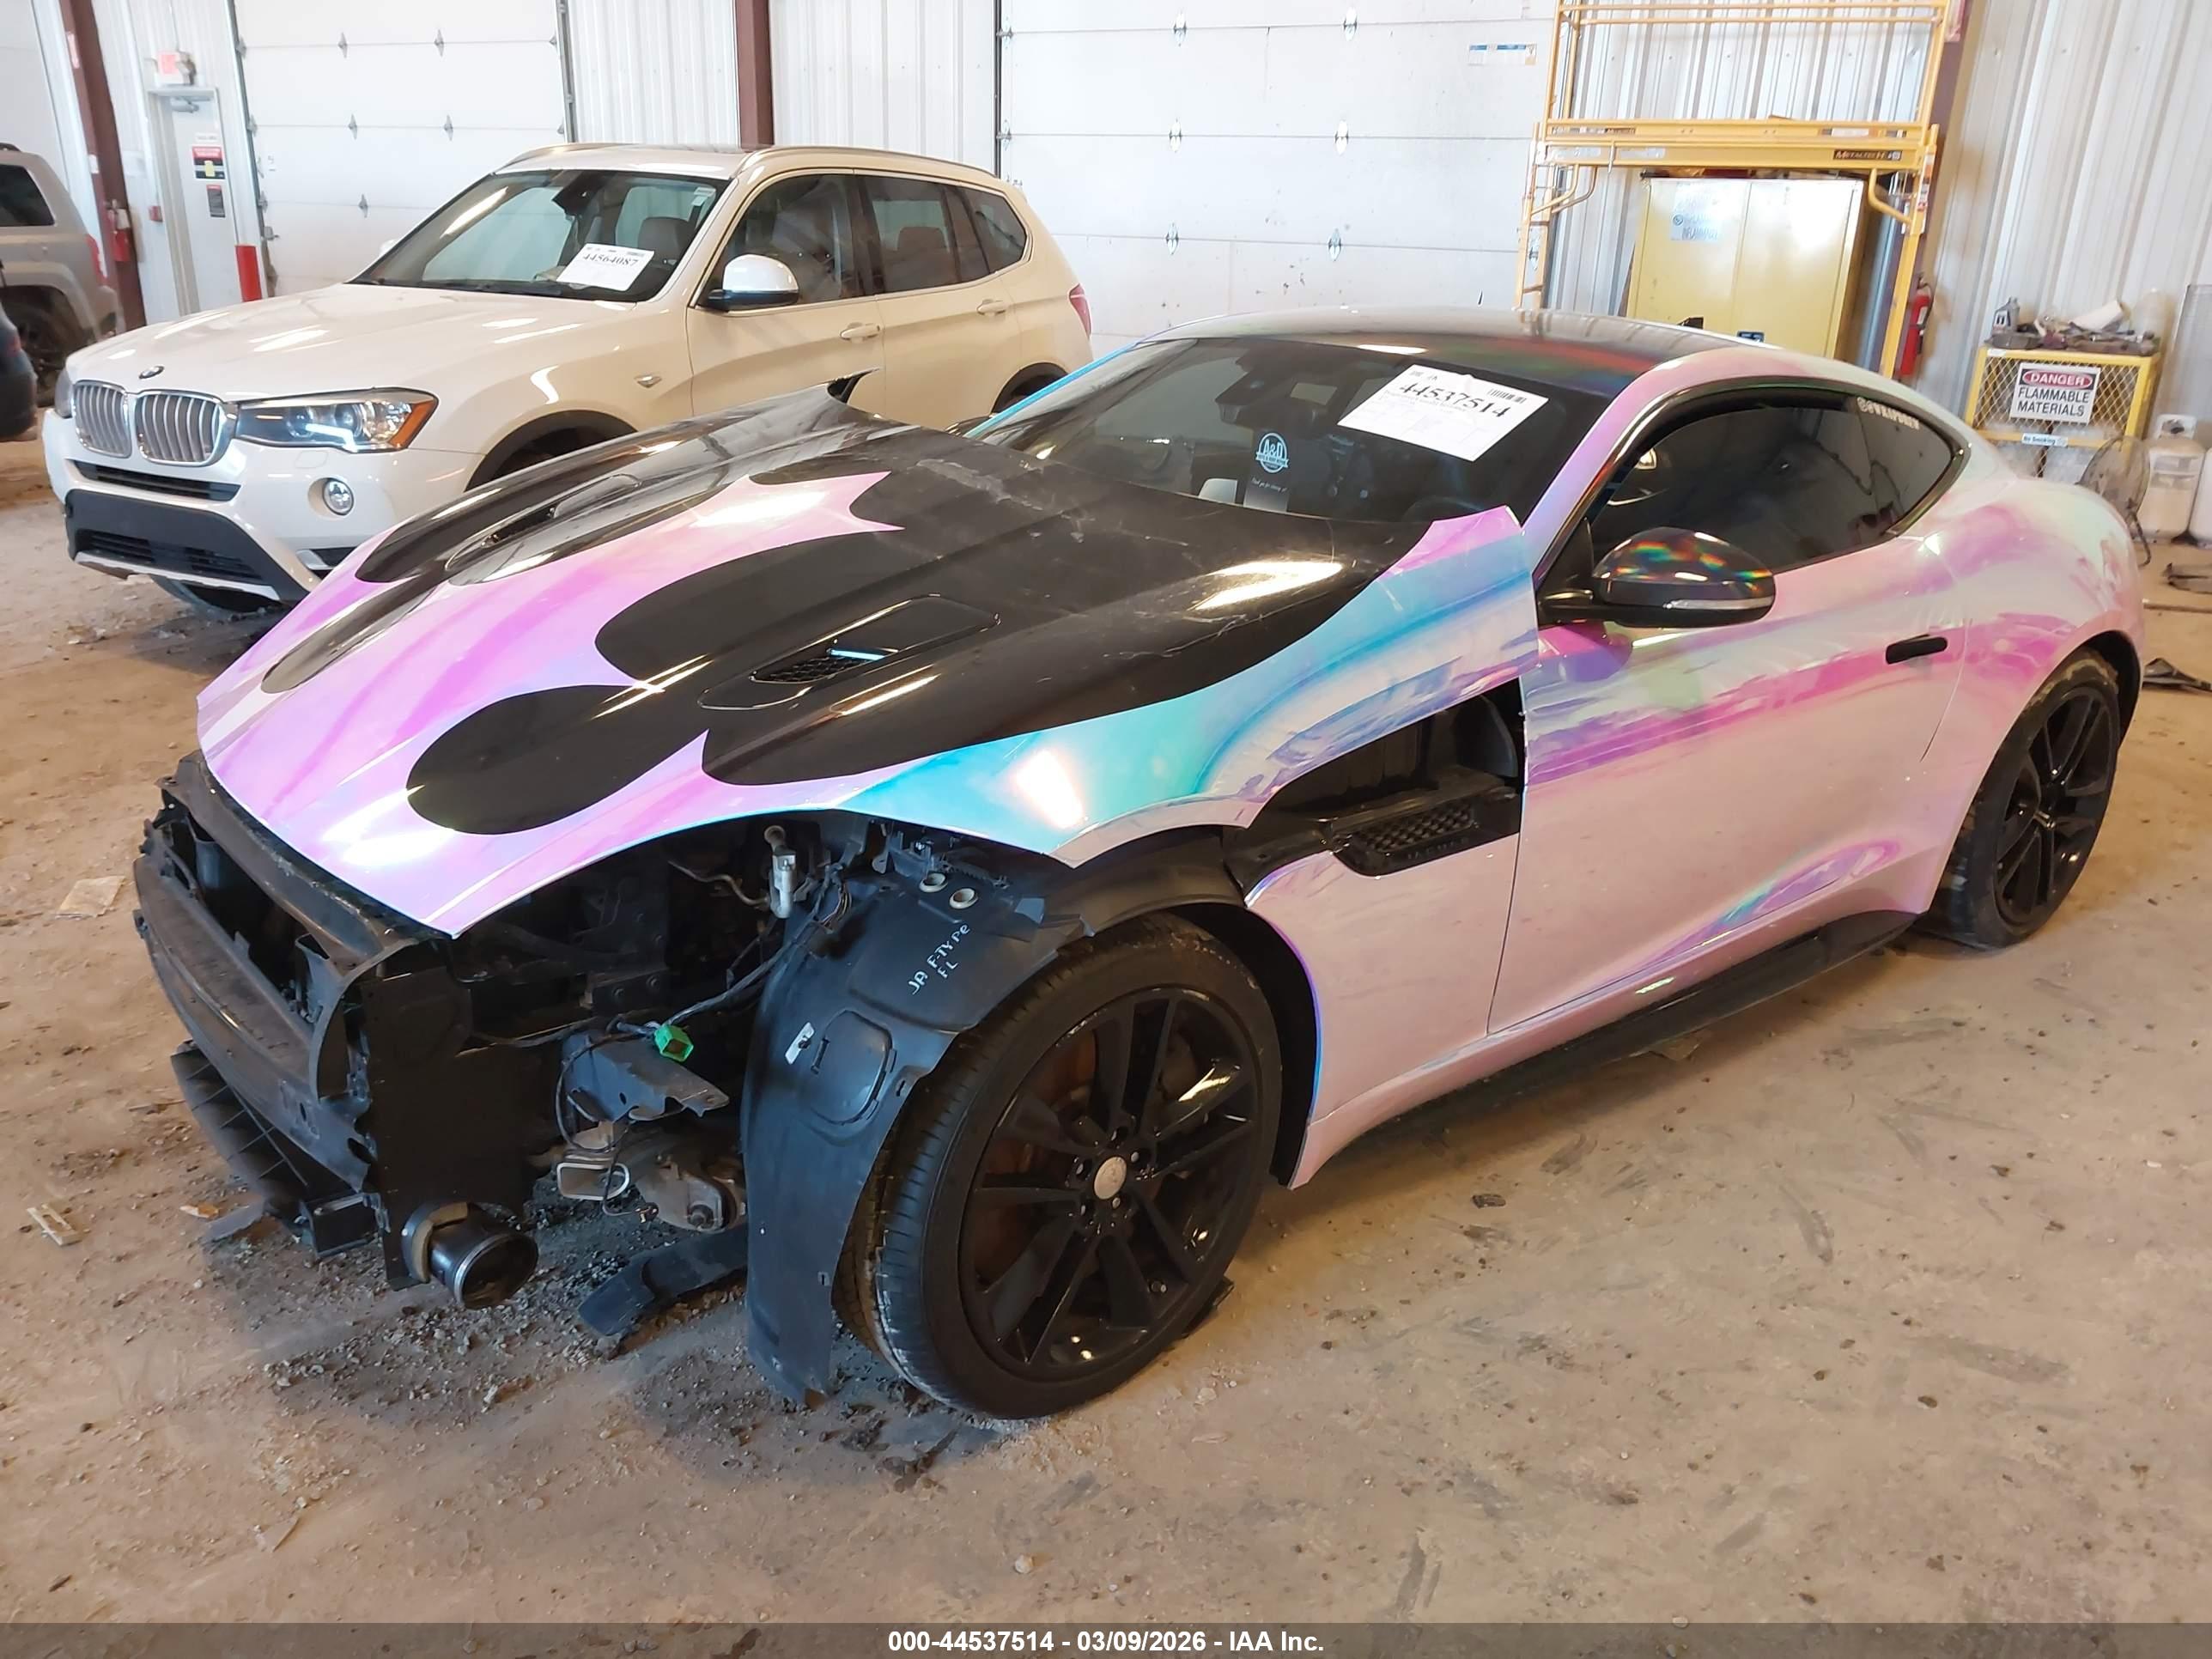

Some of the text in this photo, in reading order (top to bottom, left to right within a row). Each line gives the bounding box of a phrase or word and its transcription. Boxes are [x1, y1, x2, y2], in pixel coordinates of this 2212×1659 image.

[582, 252, 639, 267] 44564087
[2030, 373, 2085, 386] DANGER
[1400, 382, 1511, 417] 44537514
[2018, 386, 2090, 404] FLAMMABLE
[2017, 400, 2085, 417] MATERIALS
[1263, 439, 1283, 457] A&D
[937, 961, 959, 978] FL
[908, 970, 928, 995] JA
